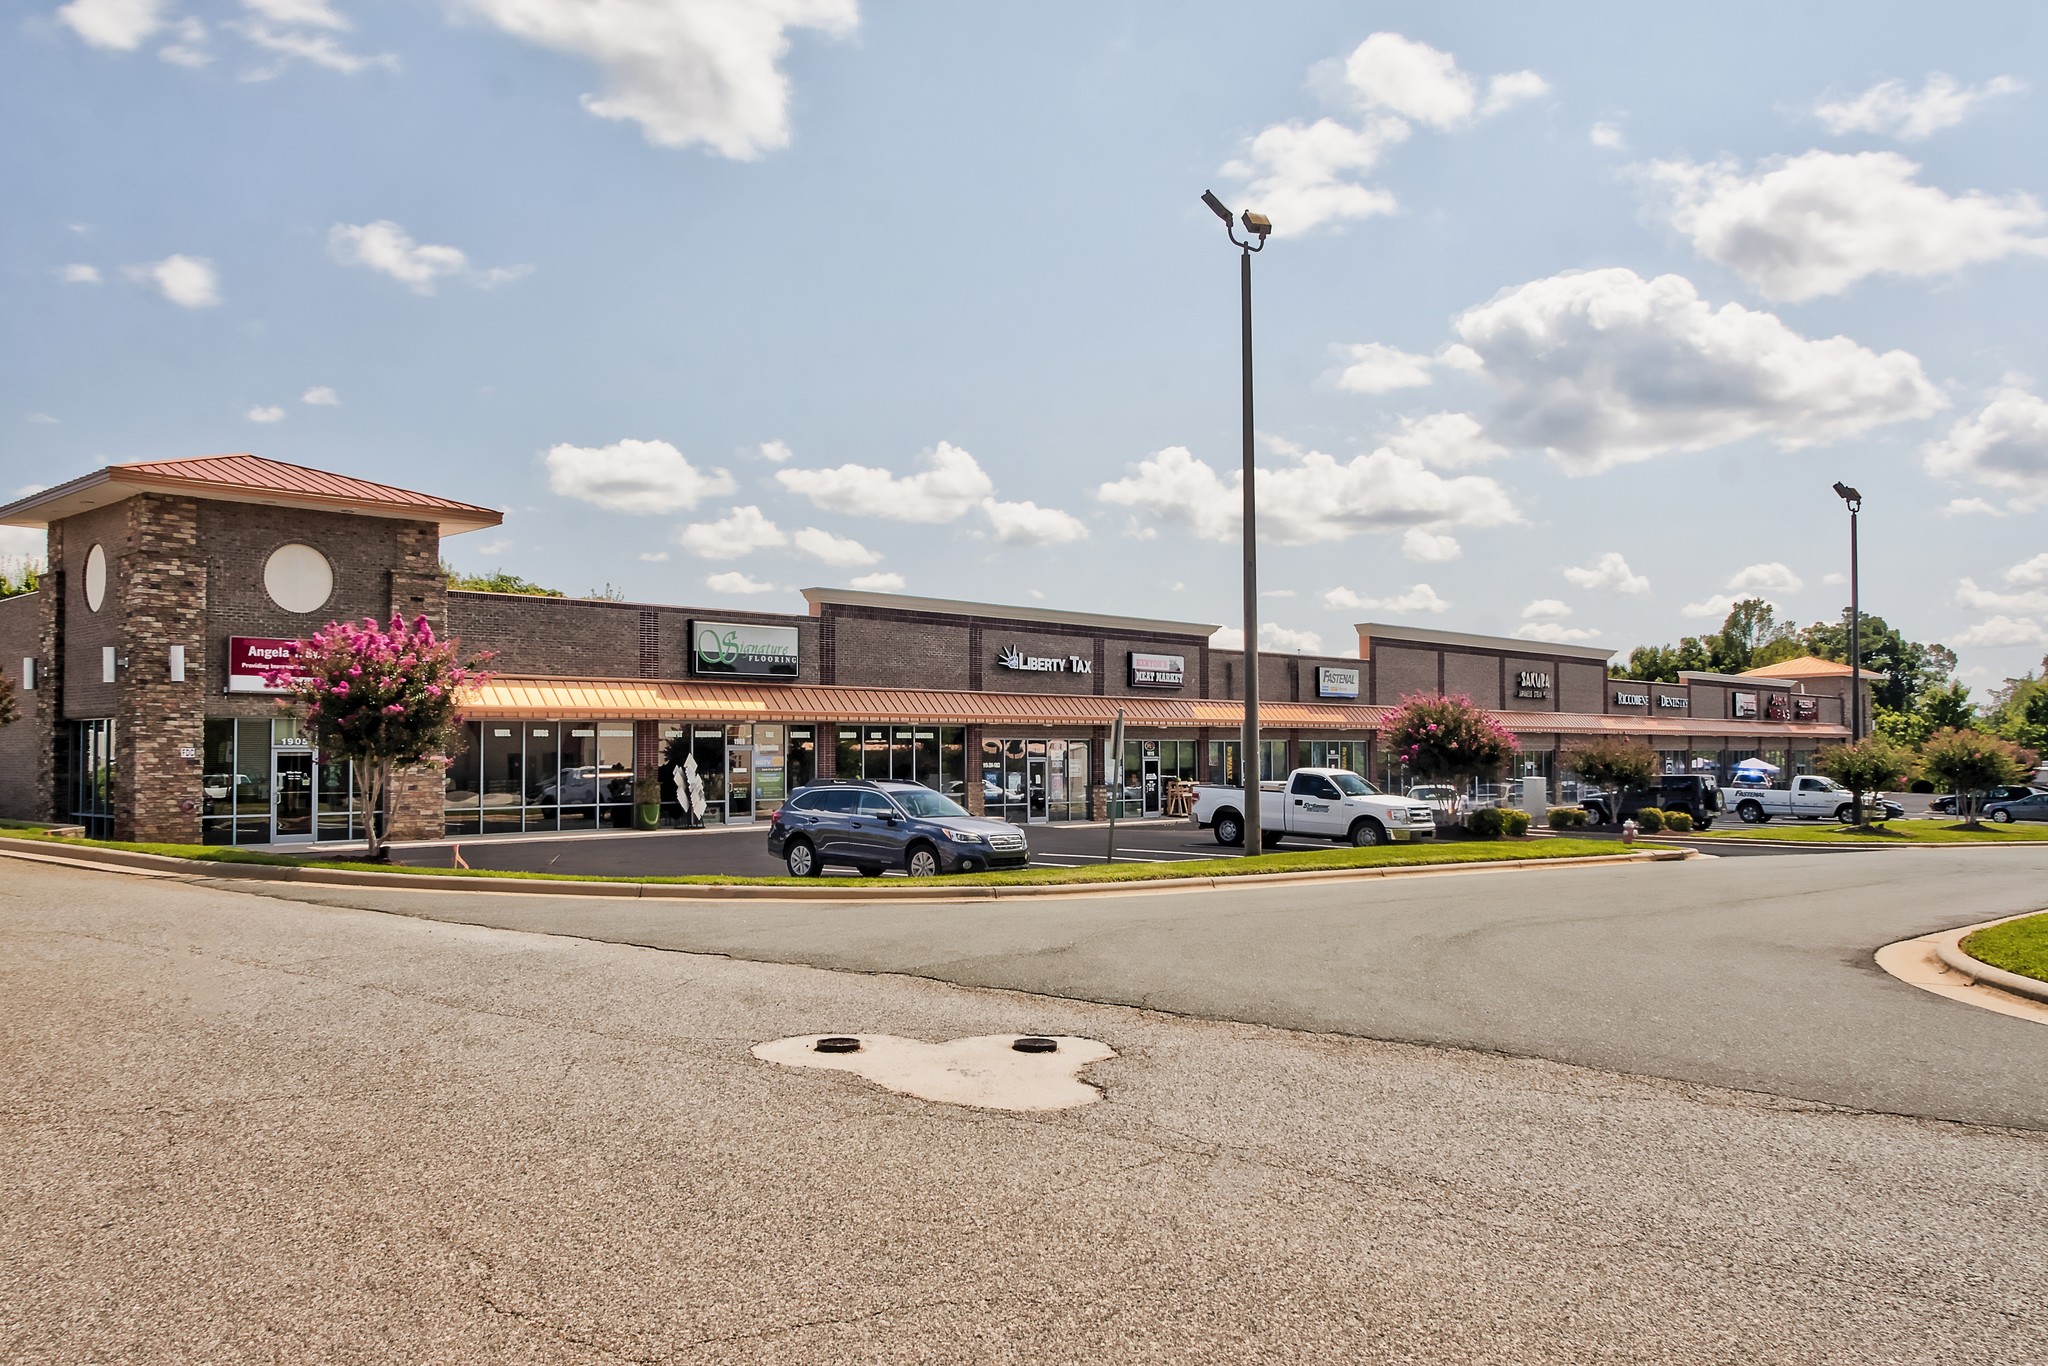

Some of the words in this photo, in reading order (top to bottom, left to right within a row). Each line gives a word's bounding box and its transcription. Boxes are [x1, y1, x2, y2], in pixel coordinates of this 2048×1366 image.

[248, 645, 289, 660] Angela
[698, 630, 788, 665] Signature
[241, 662, 270, 670] Providing
[749, 655, 797, 664] FLOORING
[1069, 655, 1091, 674] TAX
[1135, 671, 1155, 682] MEAT
[1156, 672, 1183, 683] MARKET
[1322, 670, 1355, 685] FASTENAL
[1520, 671, 1550, 689] SAKURA
[1617, 692, 1650, 706] RICCOBENE
[1660, 695, 1689, 708] DENTISTRY
[1734, 789, 1766, 798] FASTENAL
